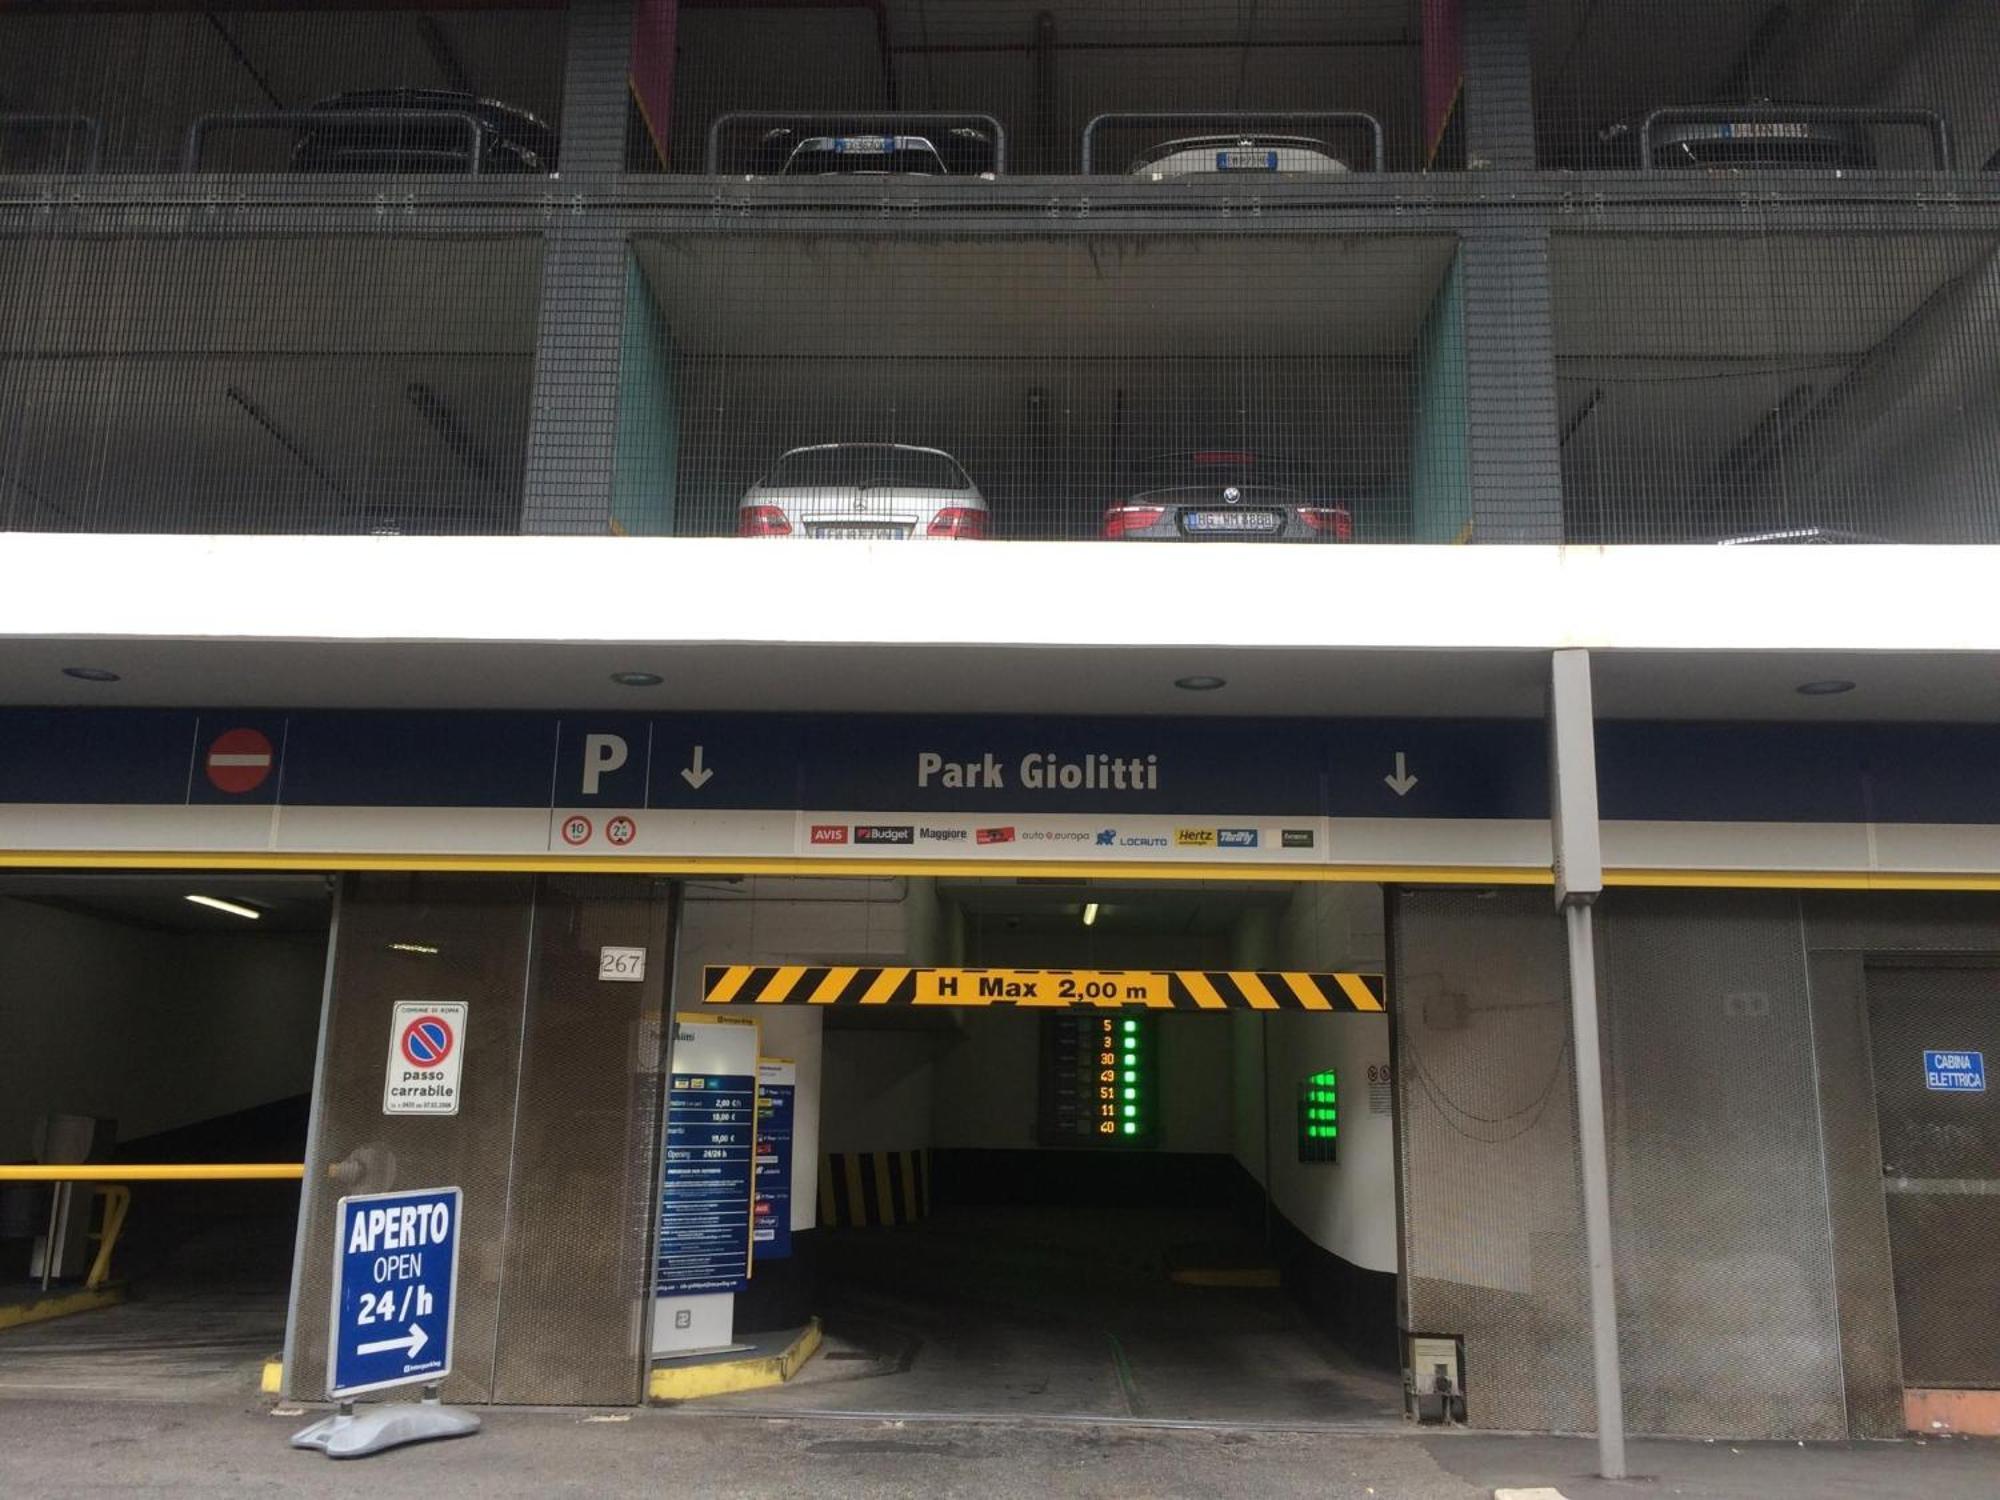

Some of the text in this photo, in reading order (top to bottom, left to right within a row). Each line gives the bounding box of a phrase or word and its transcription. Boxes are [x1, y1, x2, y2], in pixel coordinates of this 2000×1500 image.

[582, 734, 628, 794] P
[918, 753, 1157, 789] Park Giolitti
[571, 823, 585, 834] 10
[920, 827, 967, 841] Maggiore
[815, 829, 843, 841] AVIS
[871, 829, 908, 841] Budget
[1022, 832, 1045, 840] auto
[1179, 830, 1213, 841] Hertz
[1220, 831, 1254, 845] Thrifty
[1120, 837, 1168, 846] LOCAUTO
[603, 953, 641, 973] 267
[938, 976, 1147, 1001] H Max 2,00 m
[1103, 1019, 1112, 1031] 5
[1104, 1036, 1112, 1048] 3
[1100, 1053, 1115, 1065] 30
[1934, 1054, 1972, 1069] CABINA
[403, 1071, 445, 1082] passo
[1929, 1072, 1982, 1087] ELETTRICA
[391, 1084, 453, 1097] carrabile
[1100, 1087, 1114, 1099] 51
[1102, 1104, 1114, 1116] 11
[1100, 1121, 1115, 1133] 40
[348, 1202, 449, 1254] APERTO
[373, 1252, 422, 1283] OPEN
[357, 1284, 433, 1325] 24/h
